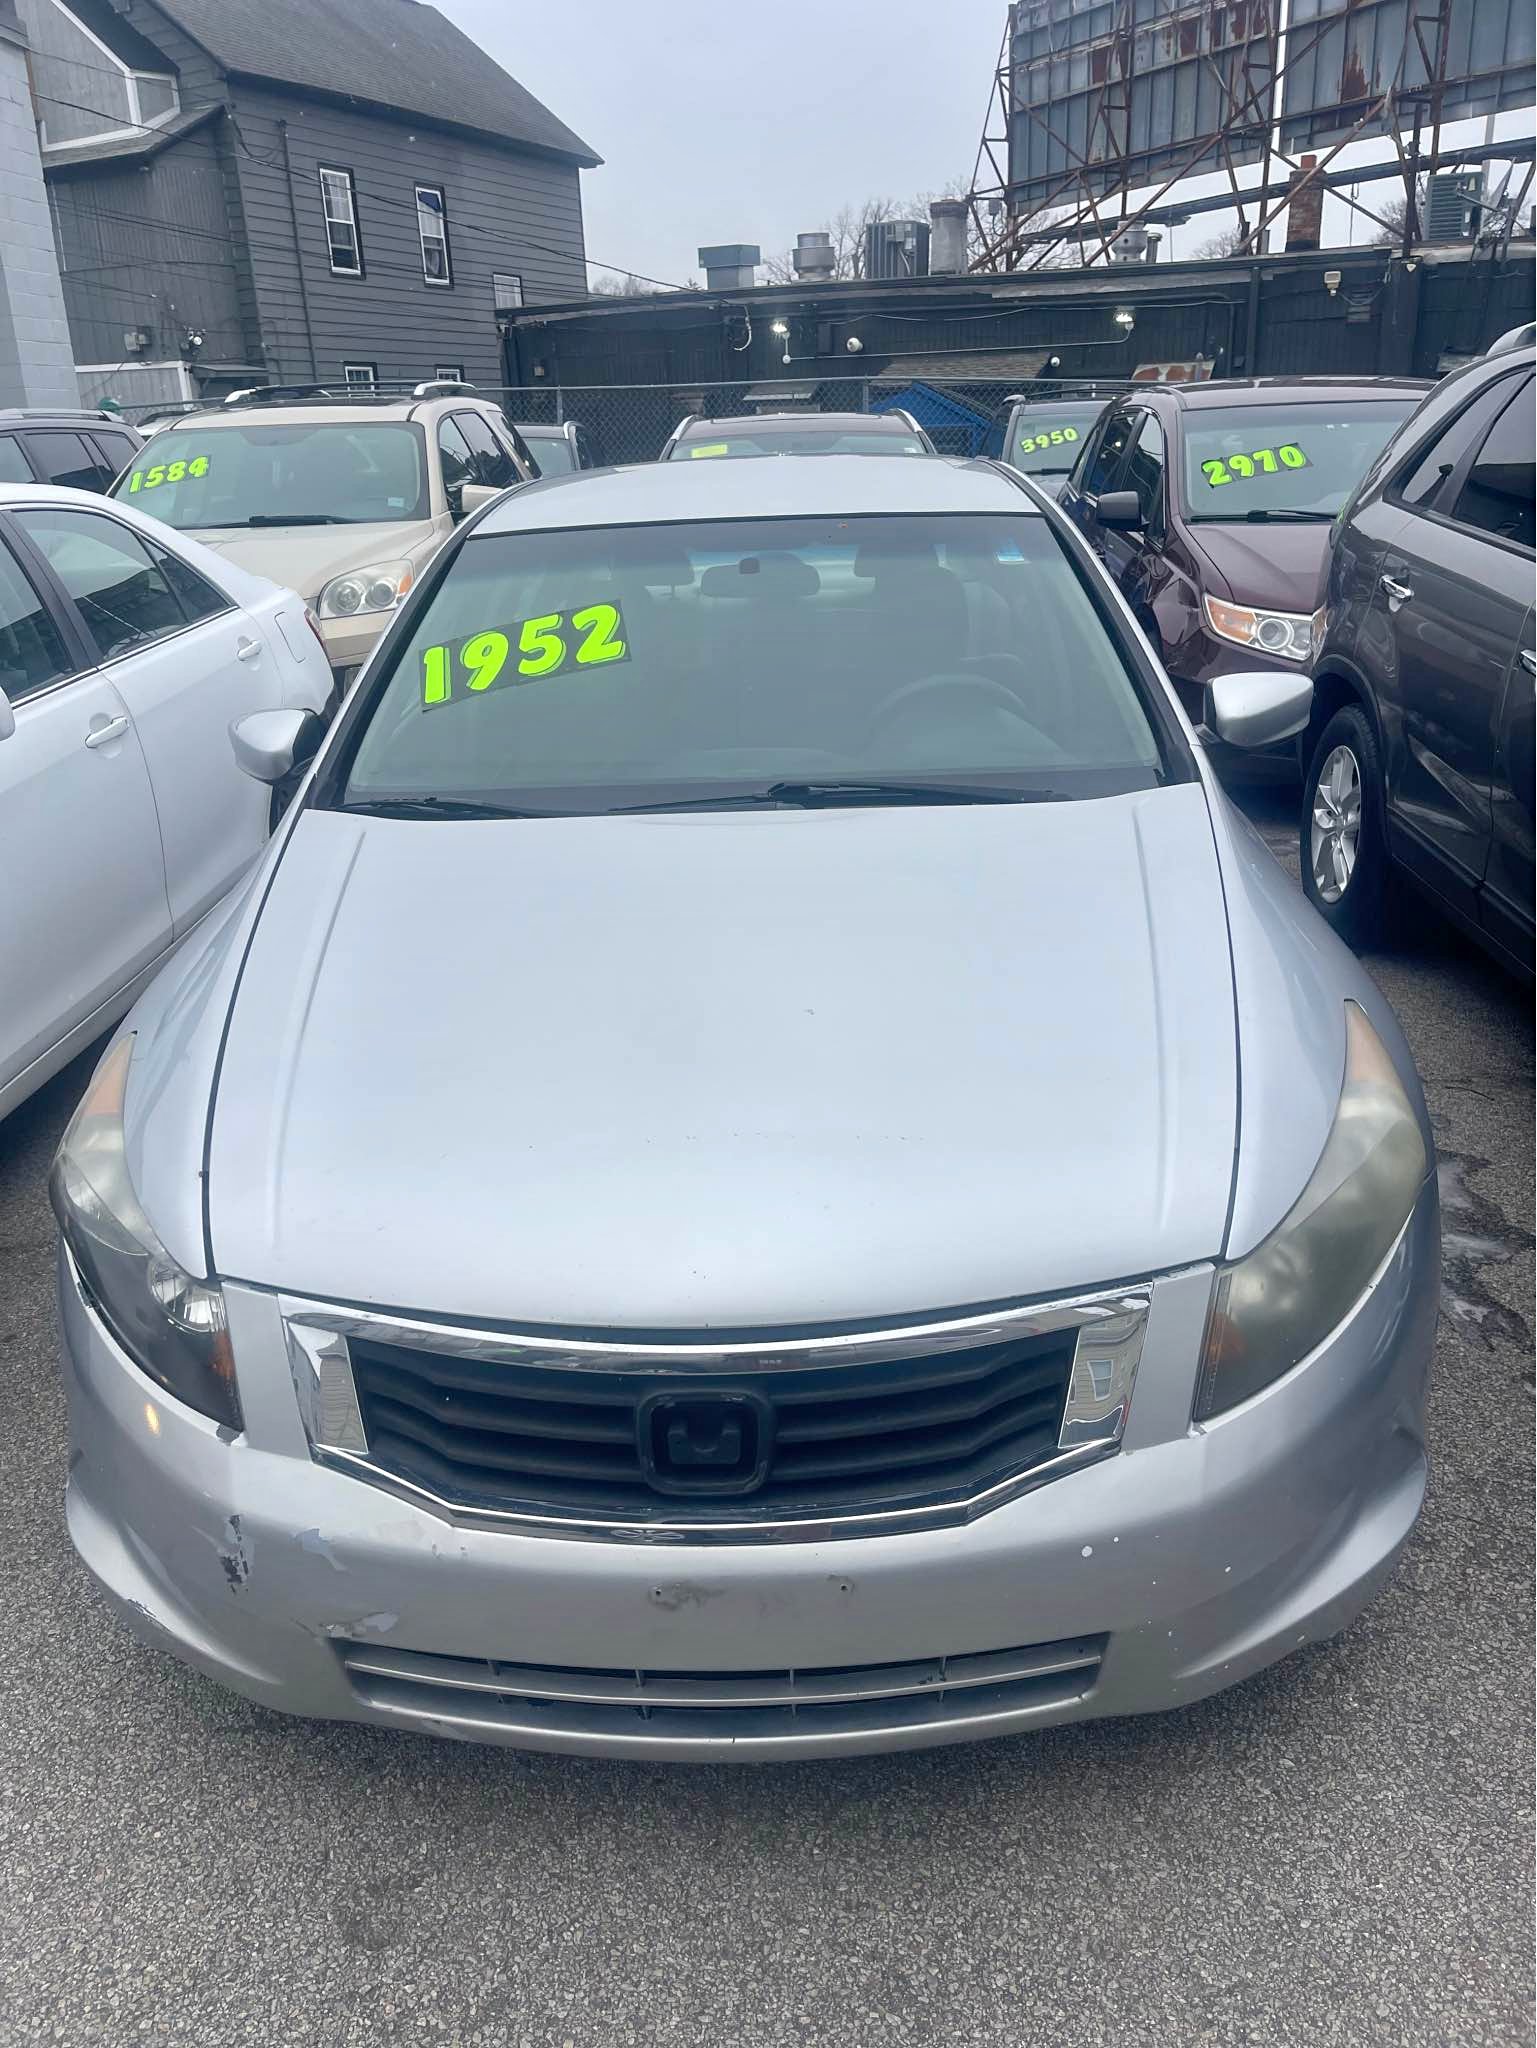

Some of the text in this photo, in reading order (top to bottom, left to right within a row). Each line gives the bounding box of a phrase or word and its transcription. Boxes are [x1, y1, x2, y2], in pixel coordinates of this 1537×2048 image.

[1021, 427, 1078, 453] 3950
[128, 456, 210, 493] 1584
[1202, 445, 1307, 486] 2970
[421, 603, 628, 705] 1952
